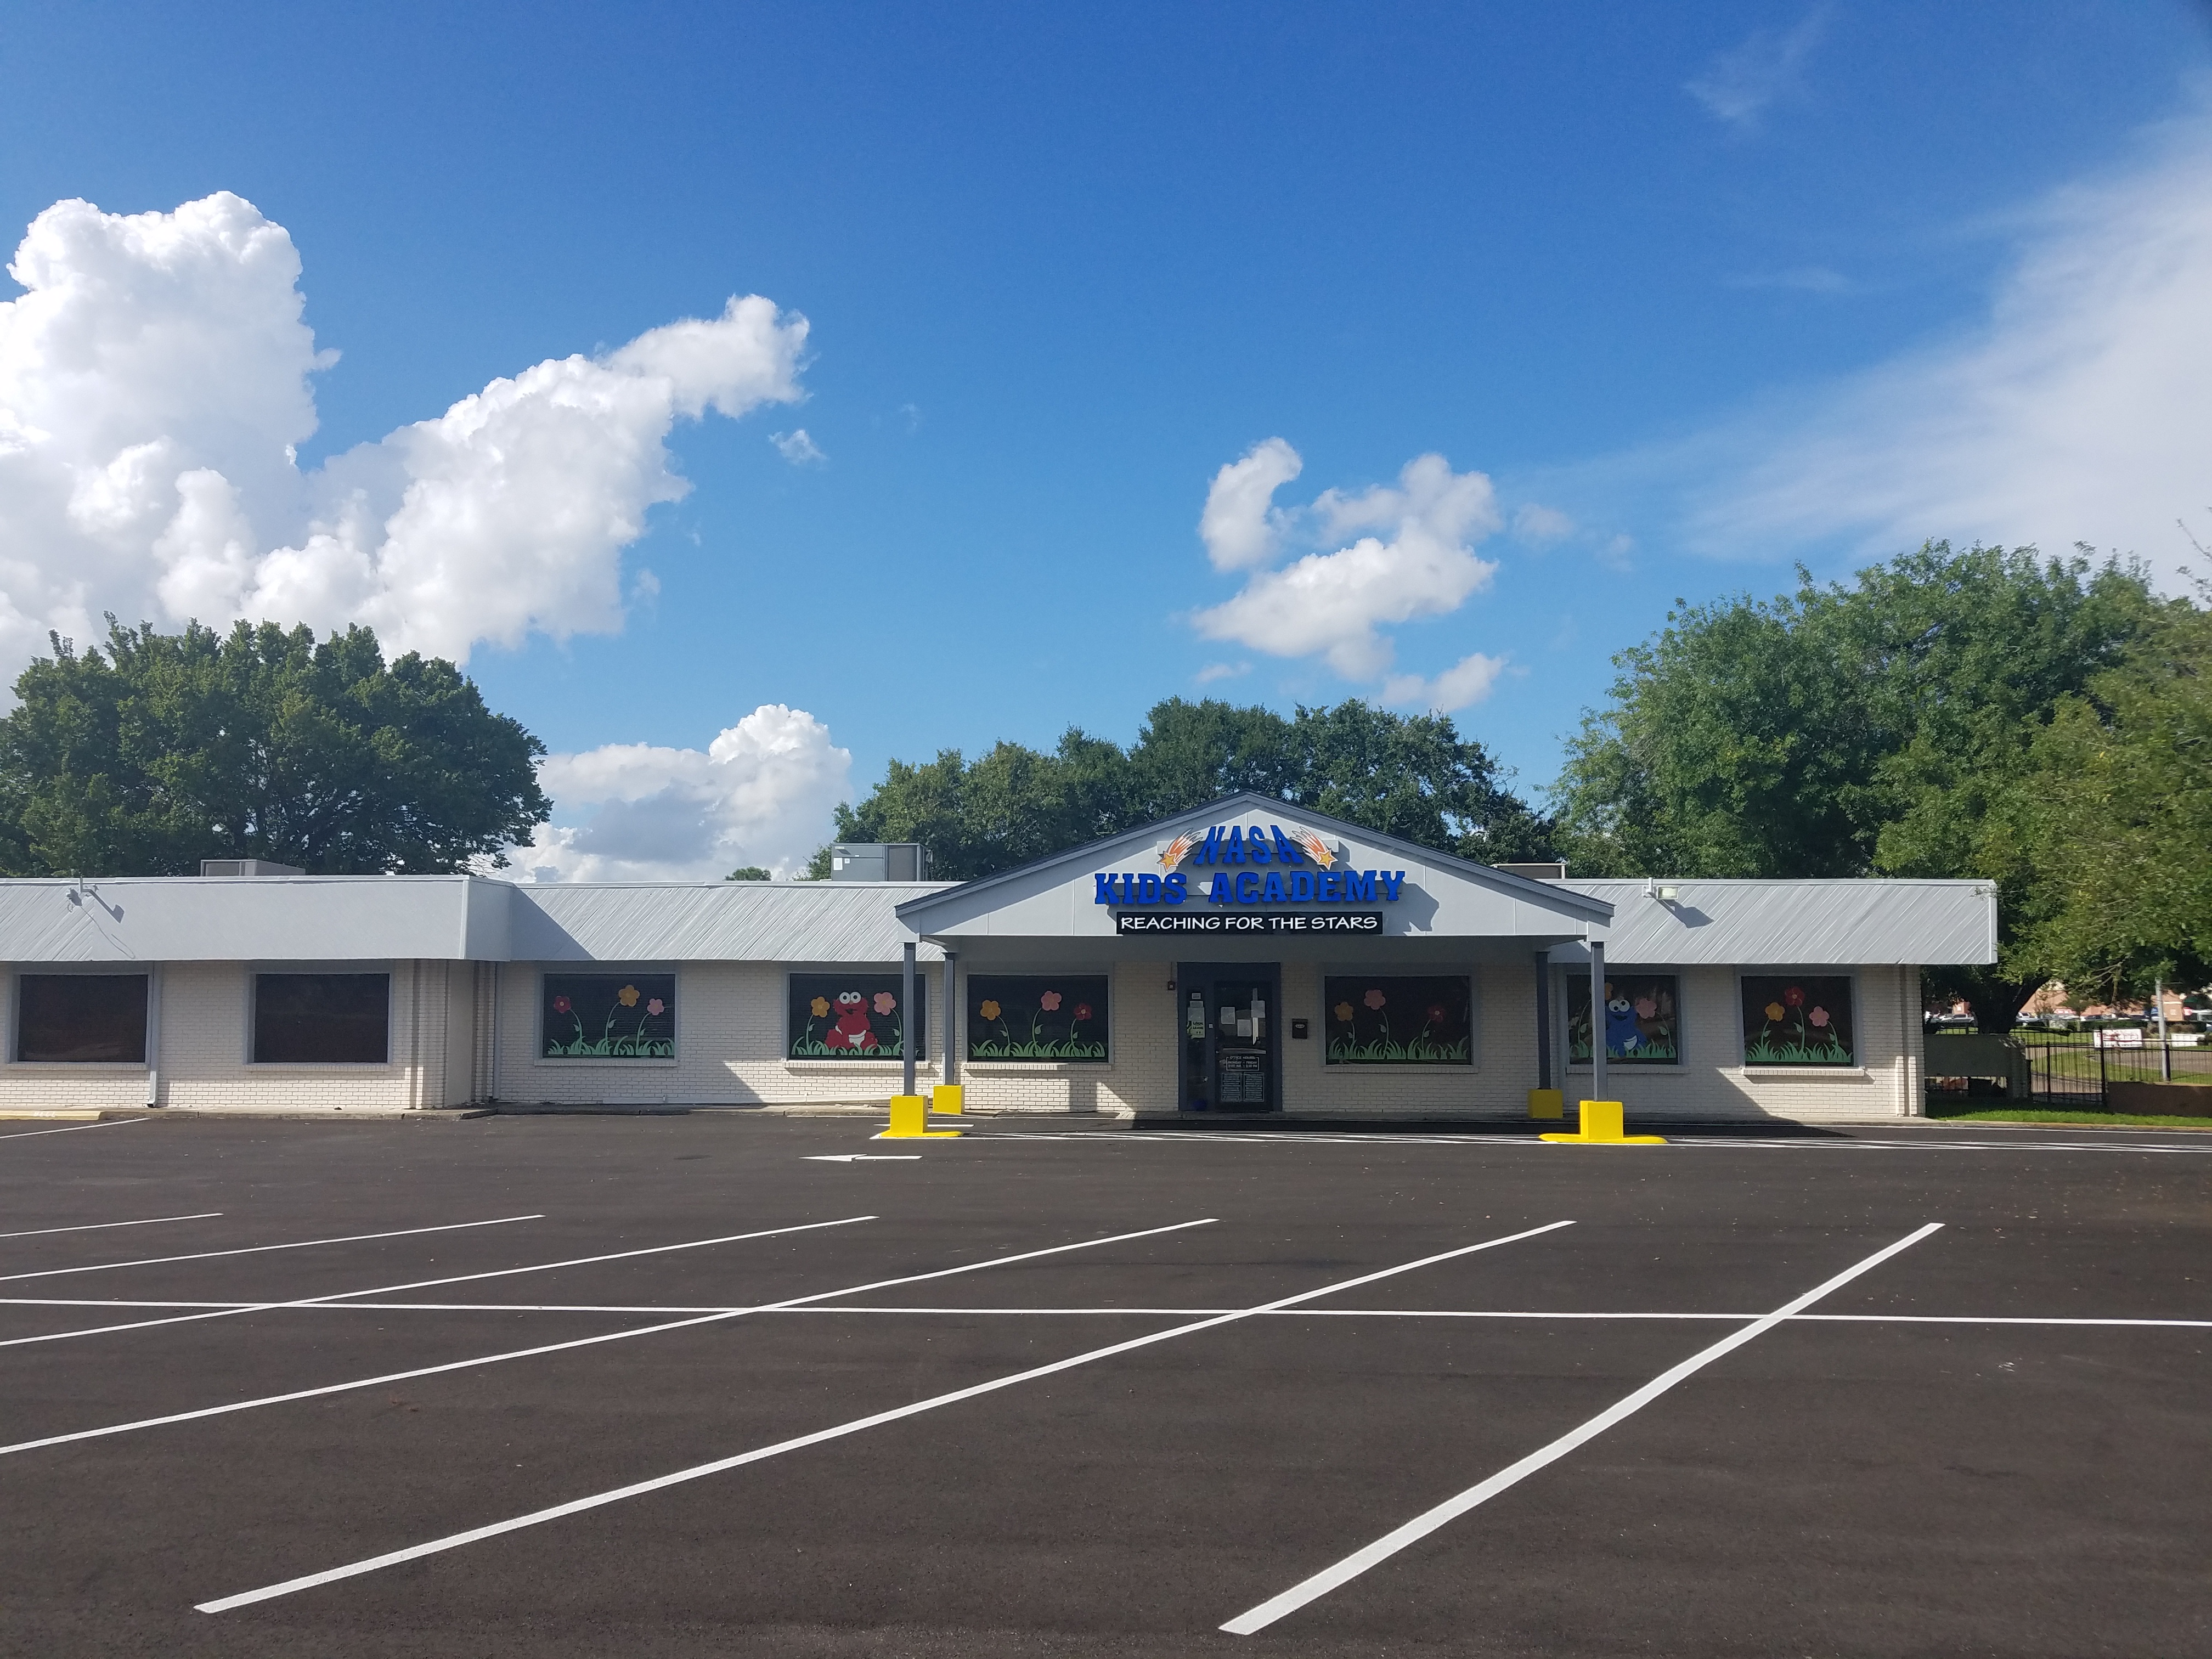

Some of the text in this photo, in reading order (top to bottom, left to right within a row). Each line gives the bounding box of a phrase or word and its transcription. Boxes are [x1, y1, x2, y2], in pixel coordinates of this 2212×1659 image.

[1193, 825, 1304, 865] NASA
[1094, 870, 1406, 905] KIDS ACADEMY
[1121, 916, 1378, 930] REACHING FOR THE STARS
